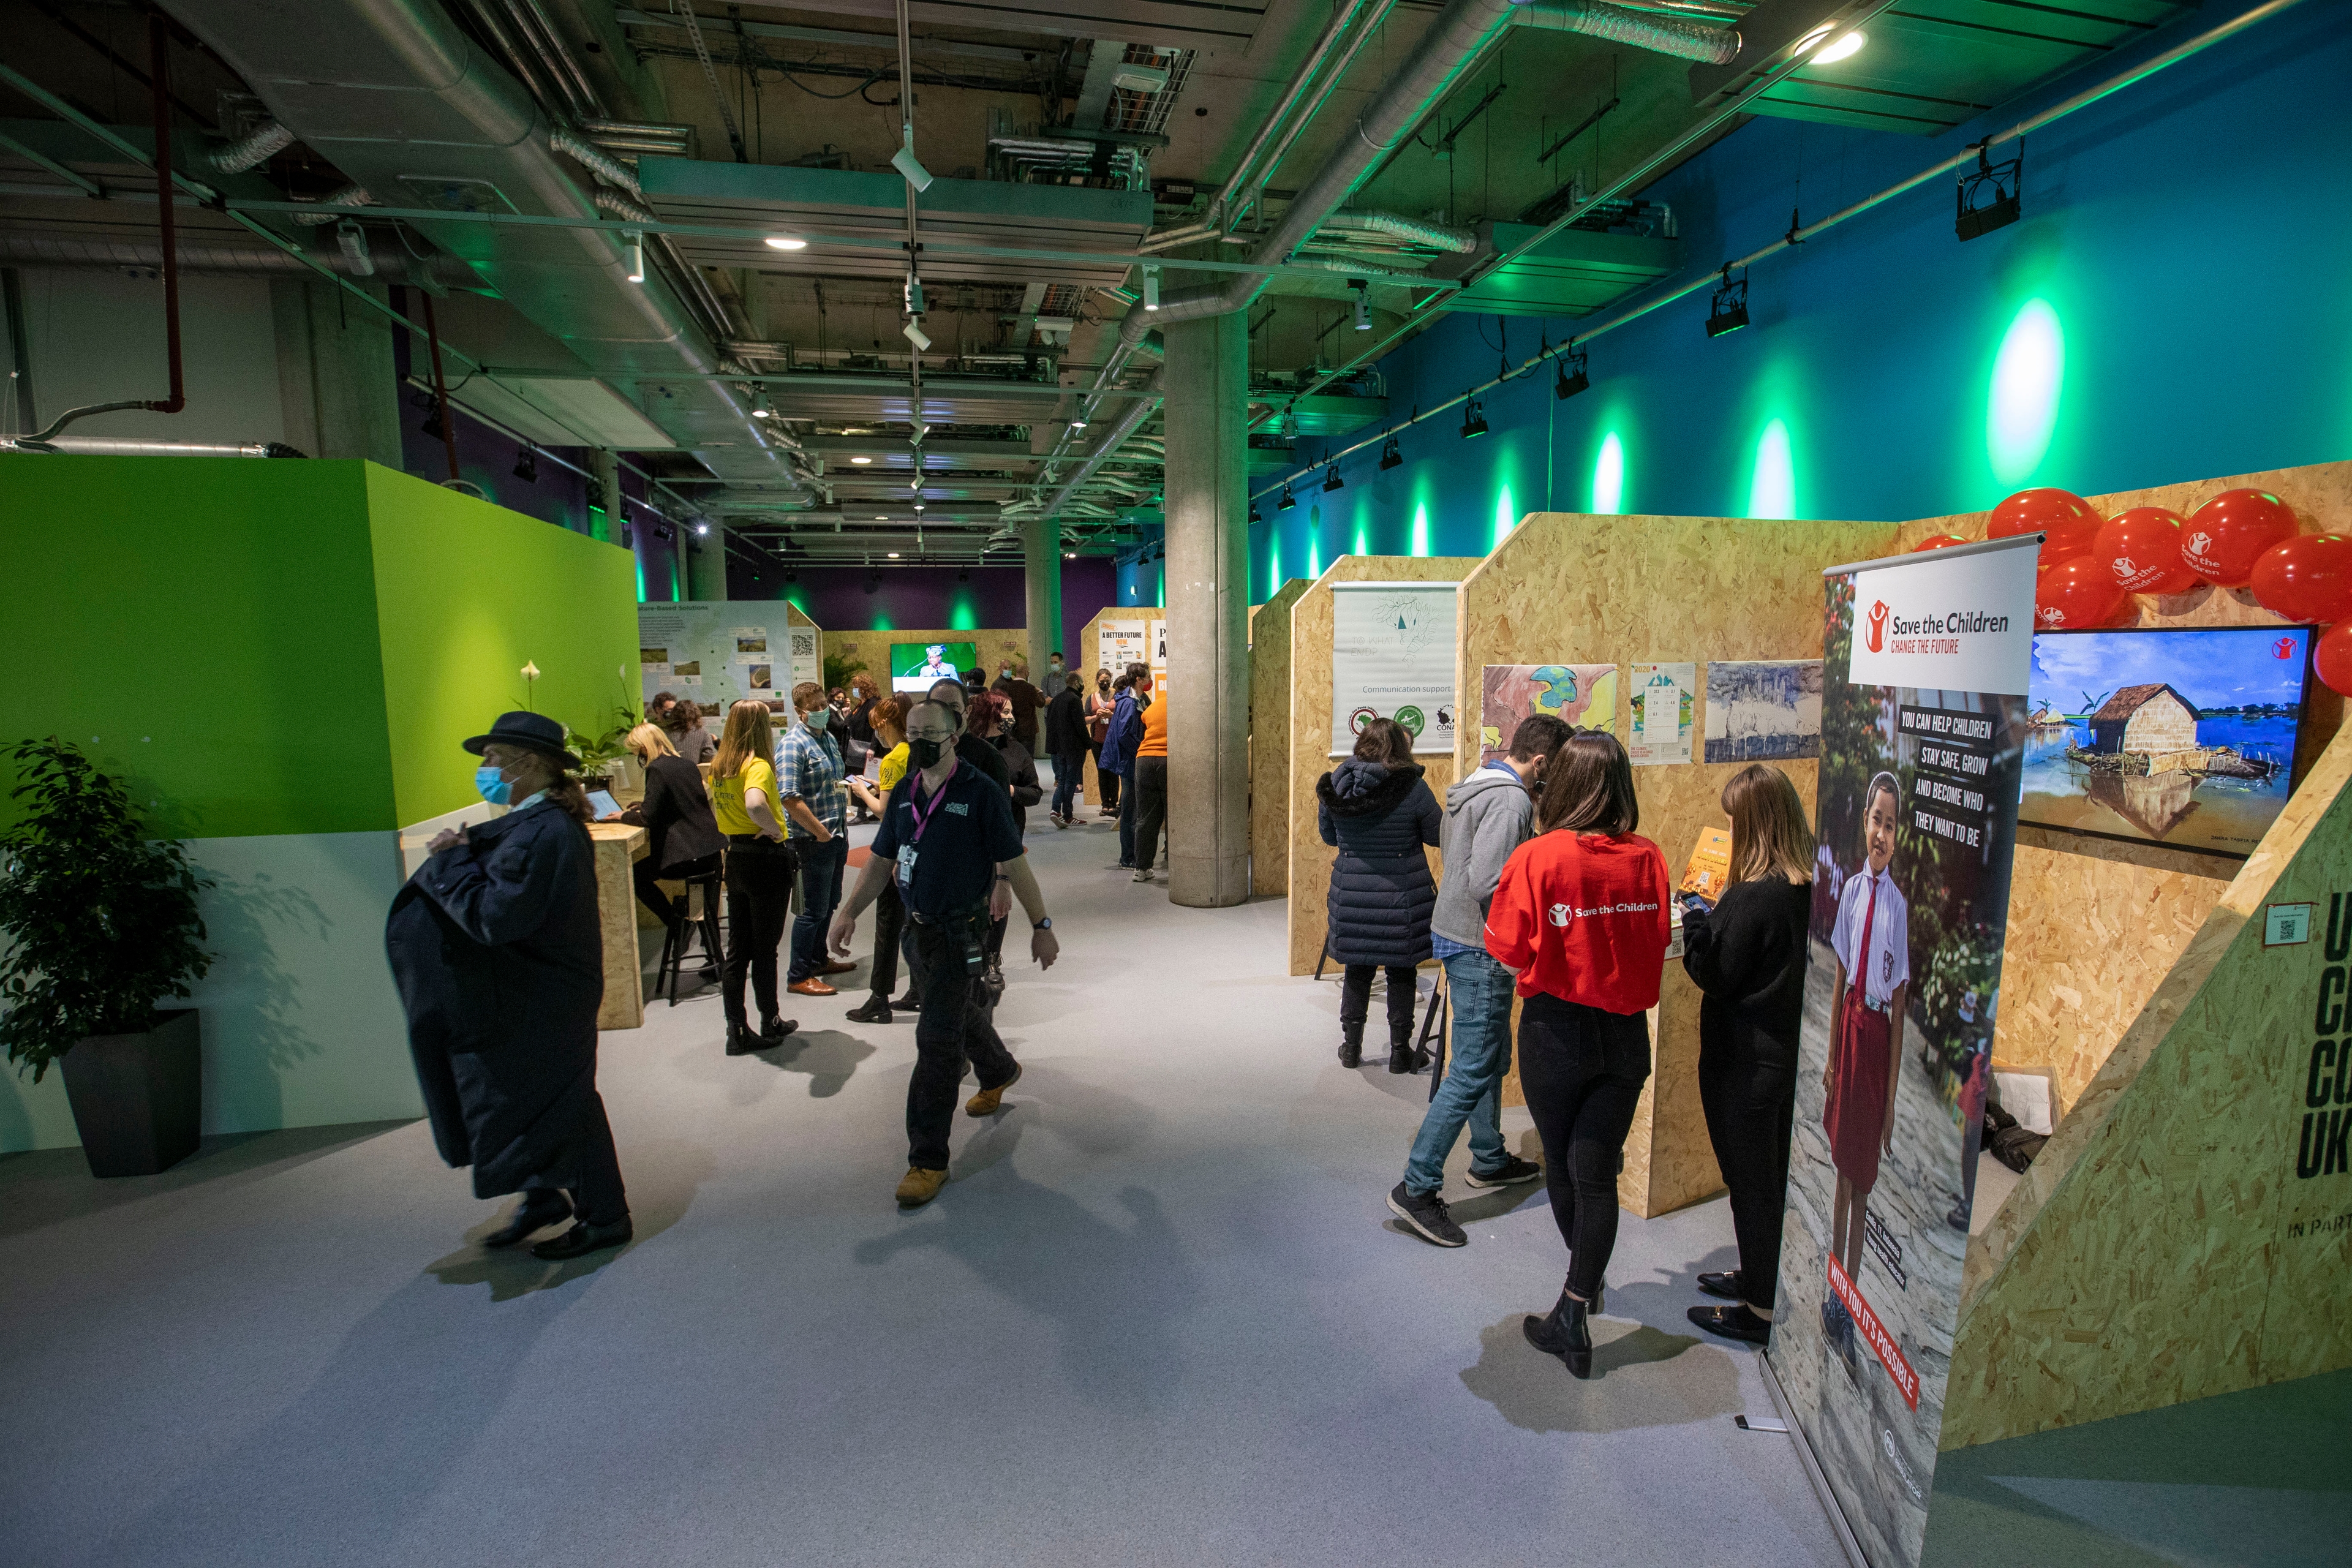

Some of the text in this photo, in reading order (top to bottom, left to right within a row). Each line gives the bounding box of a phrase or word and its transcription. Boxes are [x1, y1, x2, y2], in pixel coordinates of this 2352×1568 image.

[2199, 558, 2220, 568] the
[2116, 565, 2157, 586] Save the
[2124, 571, 2165, 591] Children
[1893, 611, 2008, 635] Save the Children
[1351, 647, 1378, 657] END?
[1891, 638, 1959, 654] CHANGE THE FUTURE
[1422, 685, 1450, 695] support
[1902, 711, 1992, 740] YOU CAN HELP CHILDREN
[1921, 747, 1988, 776] STAY SAFE, GROW
[1915, 778, 1984, 812] AND BECOME WHO
[1915, 811, 1980, 848] THEY WANT TO BE
[1575, 902, 1658, 918] Save the Children
[2296, 1110, 2352, 1179] UK
[2287, 1223, 2304, 1238] IN
[1831, 1259, 1914, 1400] WITH YOU IT'S POSSIBLE
